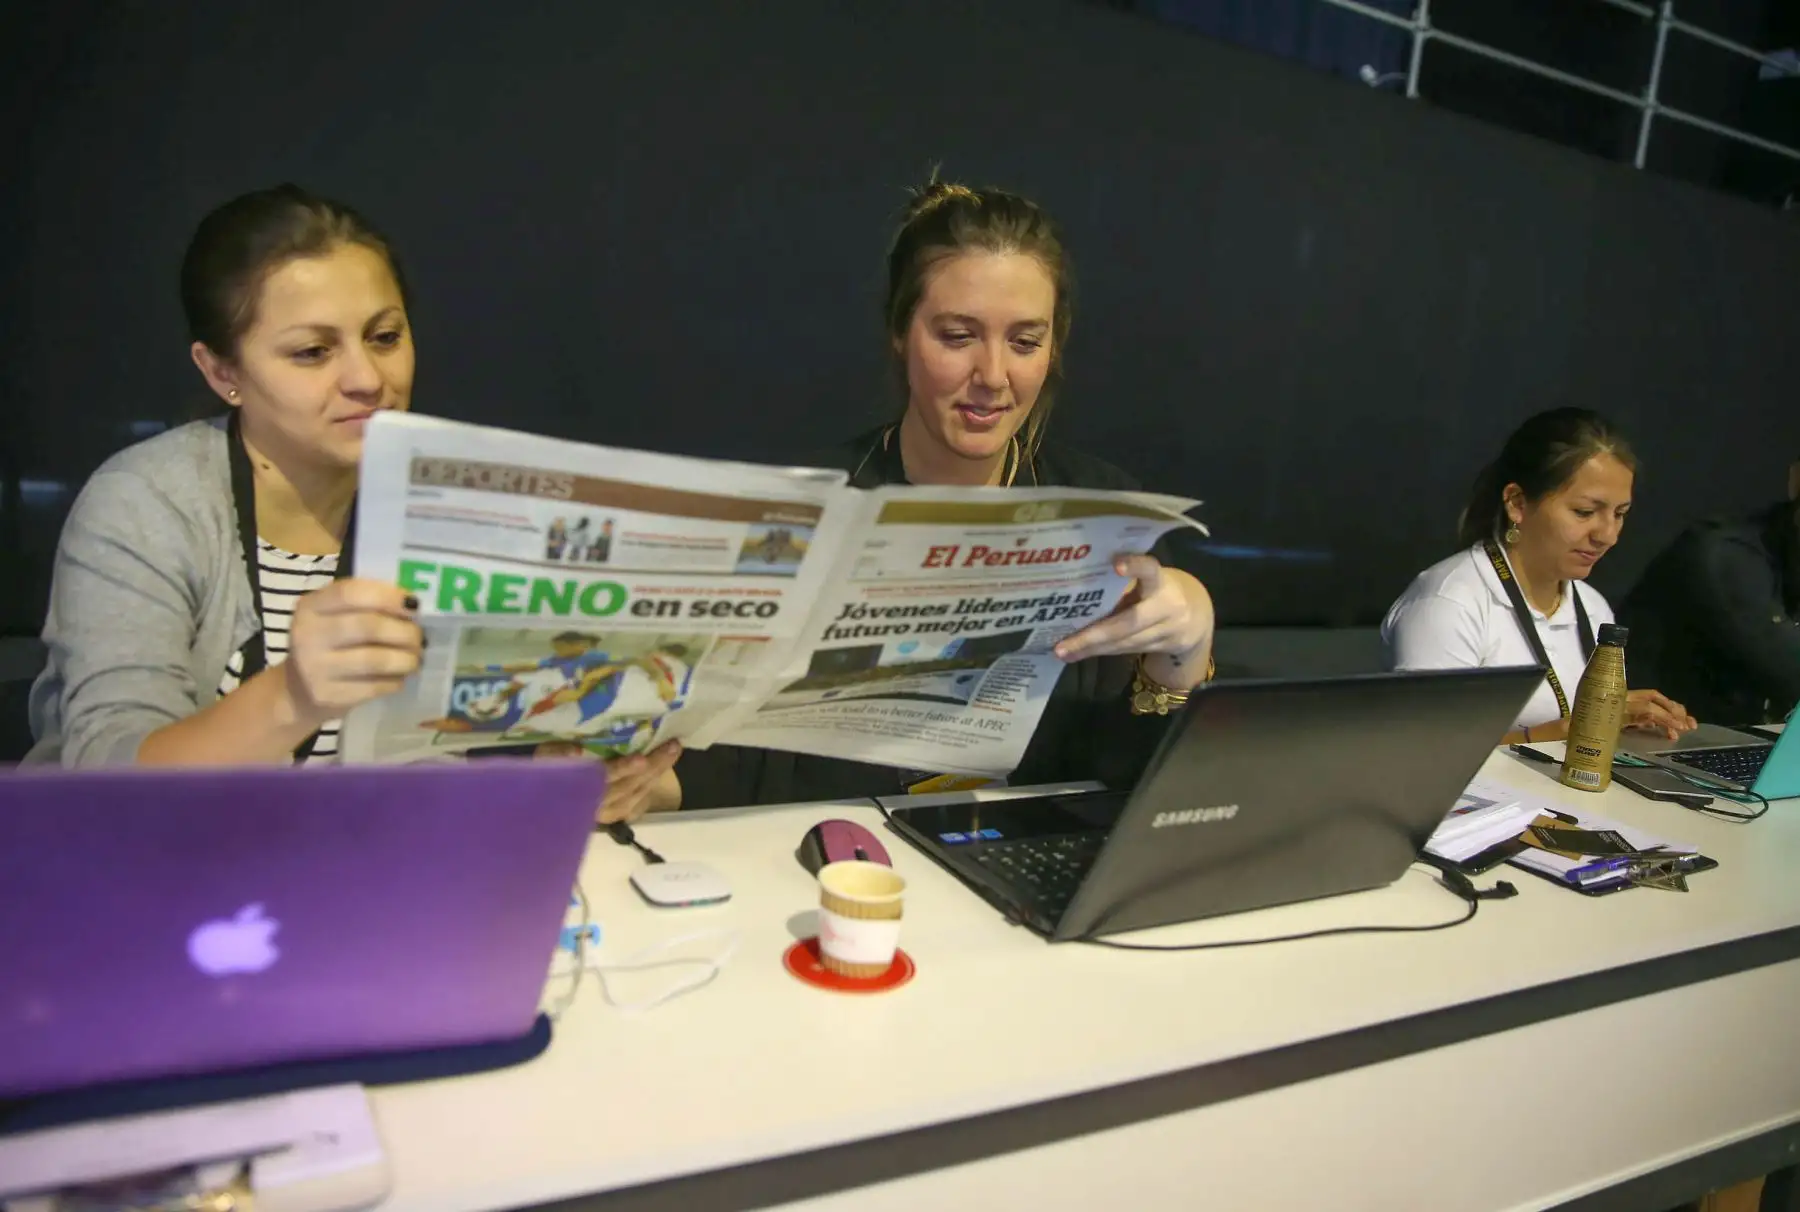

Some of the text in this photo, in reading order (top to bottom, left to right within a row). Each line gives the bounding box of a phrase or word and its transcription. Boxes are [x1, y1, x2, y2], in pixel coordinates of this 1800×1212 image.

[411, 458, 573, 498] DEPORTES
[921, 543, 1092, 568] El Peruano
[397, 560, 629, 617] FRENO
[834, 588, 1105, 621] Jóvenes liderarán un
[630, 598, 780, 618] en seco
[820, 602, 1102, 642] futuro mejor en APEC
[1151, 804, 1239, 829] SAMSUNG
